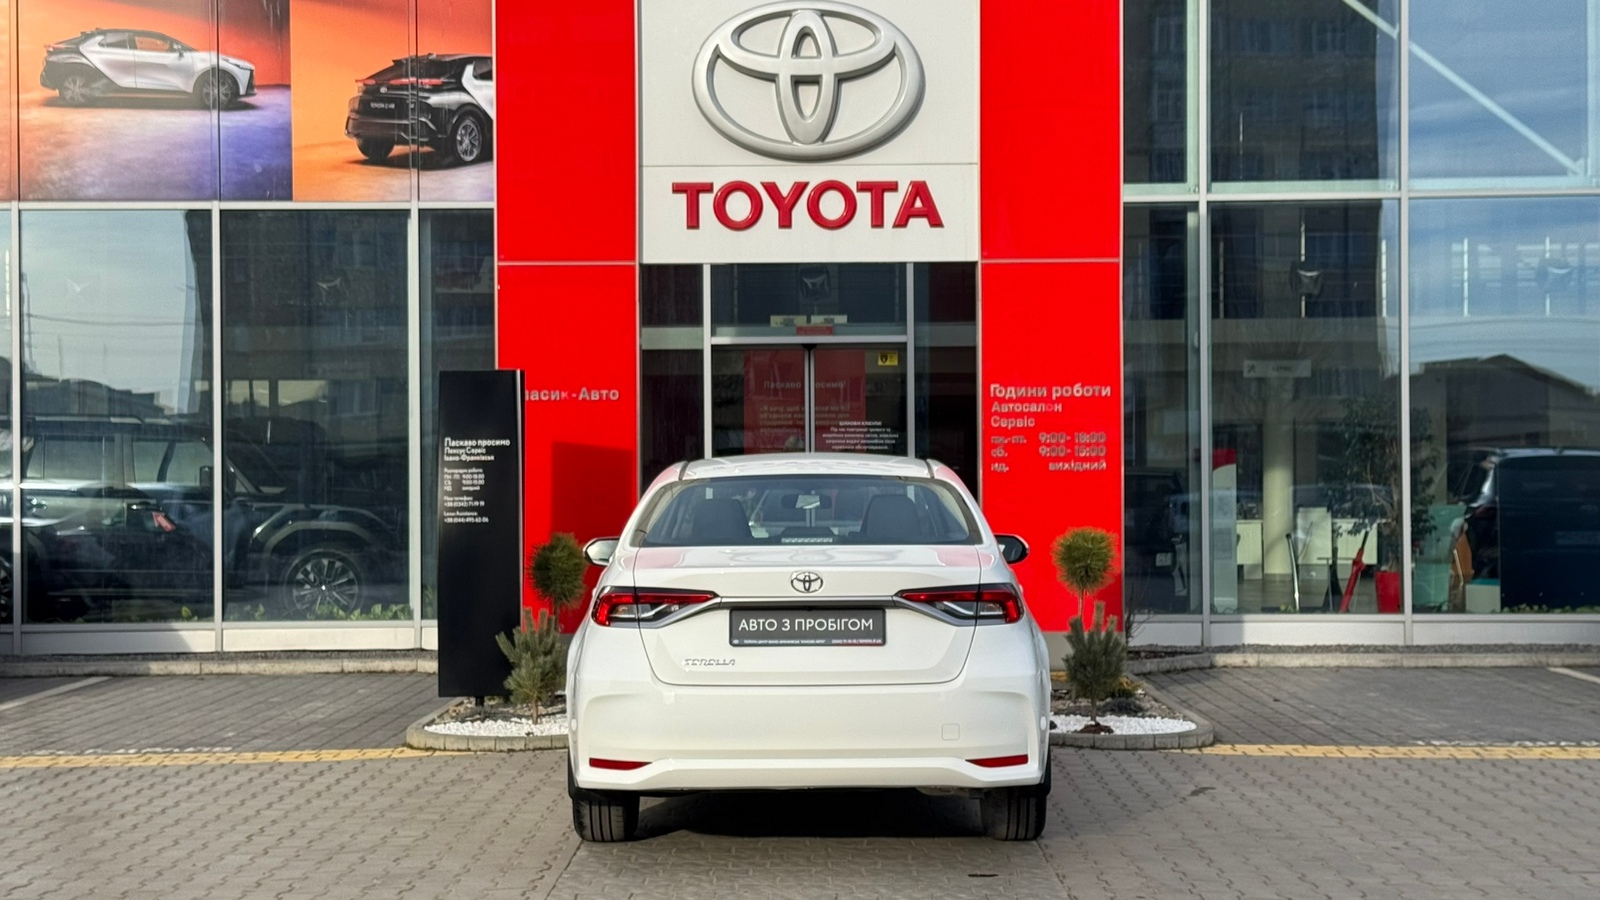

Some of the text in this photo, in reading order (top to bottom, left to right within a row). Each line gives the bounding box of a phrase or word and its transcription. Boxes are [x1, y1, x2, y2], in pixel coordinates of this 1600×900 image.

[672, 180, 945, 231] TOYOTA
[990, 382, 1111, 400] Години роботи
[991, 402, 1062, 412] Автосалон
[991, 415, 1035, 430] Сервіс
[478, 439, 511, 448] просимо
[1049, 459, 1107, 472] вихідний
[738, 618, 873, 631] АВТО З ПРОБІГОМ
